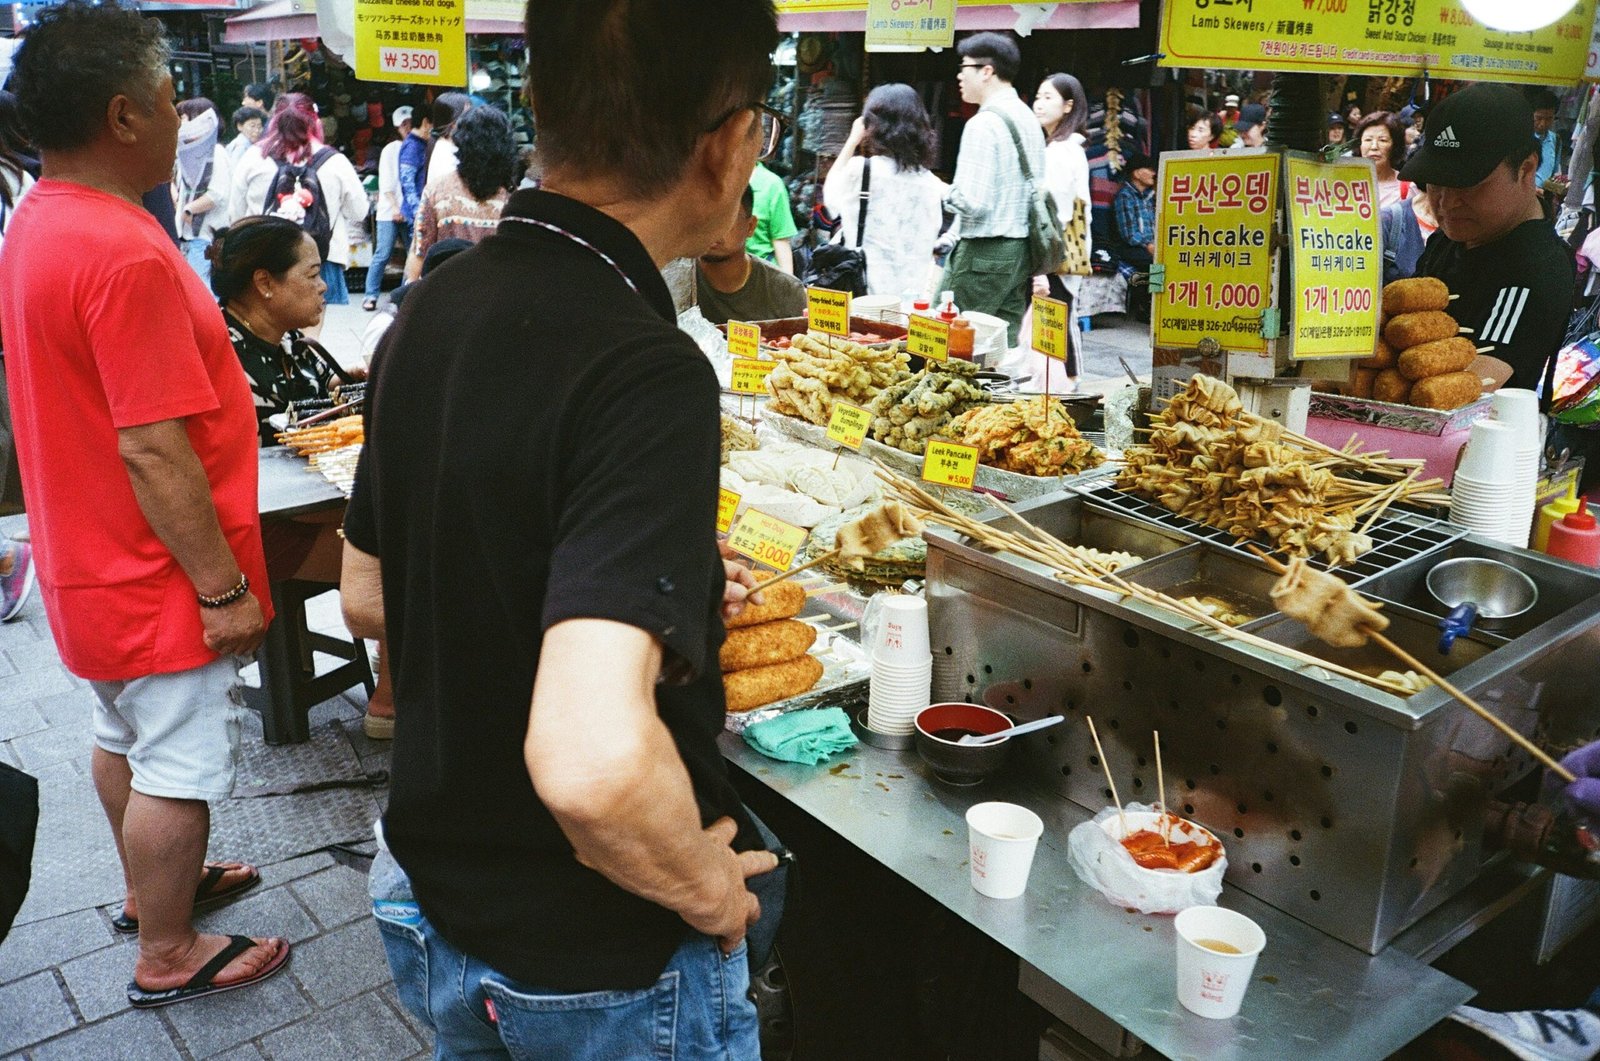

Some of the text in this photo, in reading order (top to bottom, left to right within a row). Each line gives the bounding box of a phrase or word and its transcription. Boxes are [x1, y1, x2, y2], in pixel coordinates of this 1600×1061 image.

[1368, 0, 1416, 26] 닭강정
[873, 19, 887, 29] Lamb
[890, 19, 914, 29] Skewers
[1191, 14, 1219, 29] Lamb
[1223, 17, 1264, 33] Skewers
[1365, 28, 1381, 40] Sweet
[1382, 29, 1393, 41] And
[1395, 30, 1407, 42] Sour
[1260, 40, 1337, 58] 7천원이상 카드됩니다
[1433, 139, 1461, 149] adidas
[1168, 171, 1271, 215] 부산오뎅
[1295, 176, 1372, 220] 부산오뎅
[1168, 224, 1265, 247] Fishcake
[1301, 228, 1373, 251] Fishcake
[1178, 251, 1252, 268] 피쉬케이크
[1311, 255, 1366, 272] 피쉬케이크
[1167, 281, 1261, 310] 1개 1,000
[1303, 288, 1371, 315] 1개 1,000
[814, 318, 841, 331] 오징어튀김
[932, 446, 972, 460] Leek Pancake
[941, 459, 958, 469] 부추전
[755, 541, 791, 566] 3,000
[1531, 1012, 1589, 1046] N
